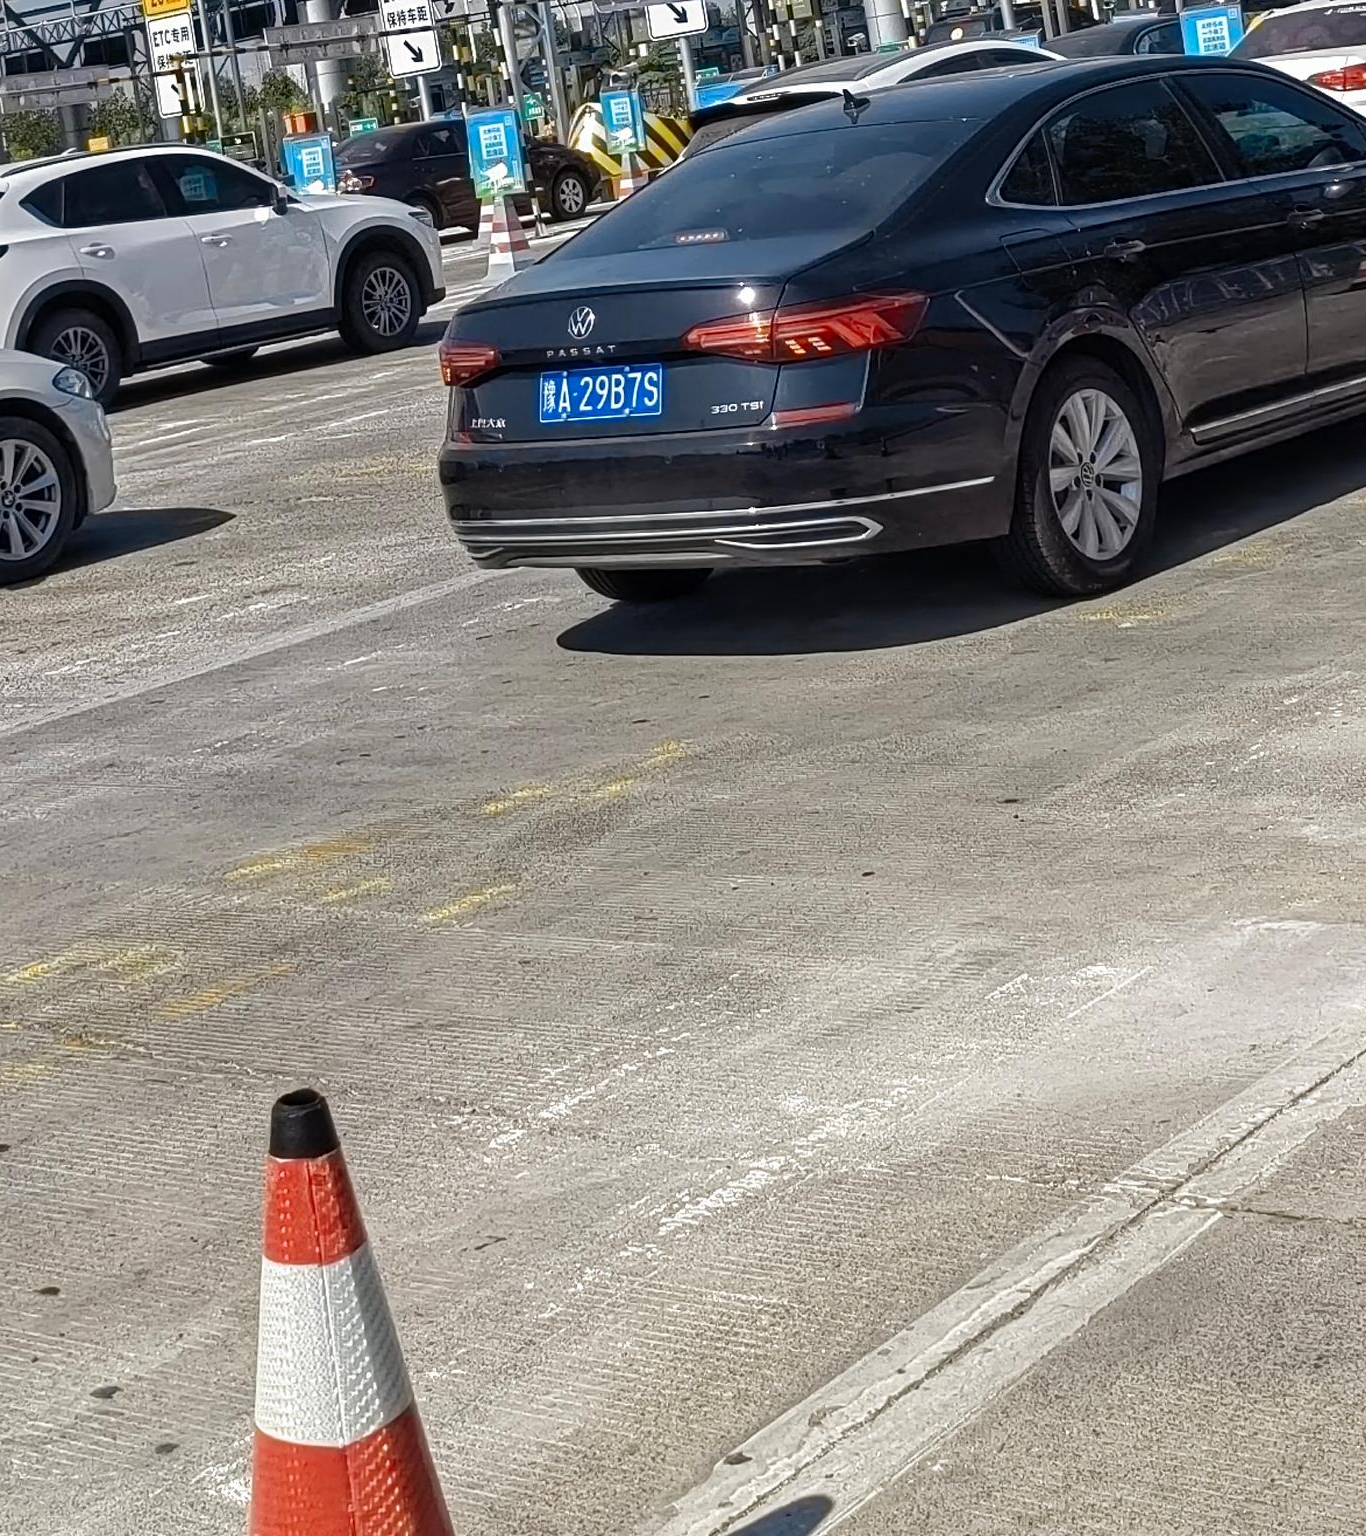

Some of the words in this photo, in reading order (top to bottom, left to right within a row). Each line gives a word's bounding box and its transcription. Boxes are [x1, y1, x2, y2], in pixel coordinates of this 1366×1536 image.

[386, 5, 429, 29] 保持车距
[152, 26, 190, 48] ETC专用
[157, 50, 194, 71] 保持距
[546, 344, 617, 359] PASSAT
[710, 403, 738, 415] 330
